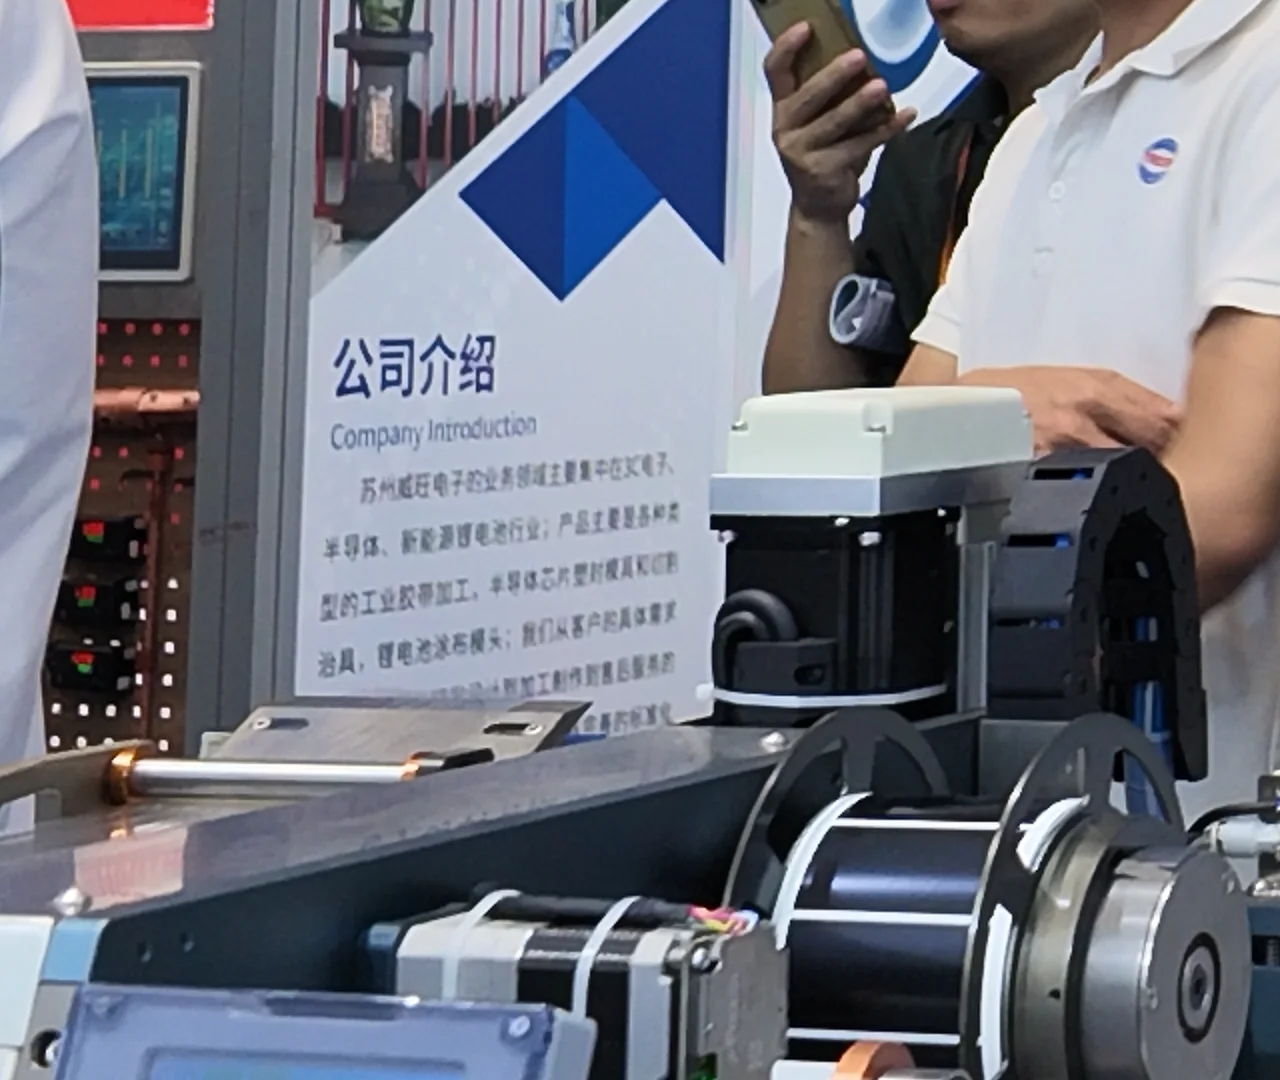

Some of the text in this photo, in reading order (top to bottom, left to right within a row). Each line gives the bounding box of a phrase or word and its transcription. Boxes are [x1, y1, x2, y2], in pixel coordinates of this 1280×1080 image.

[332, 332, 497, 400] 公司介绍
[330, 411, 538, 453] Company Introduction
